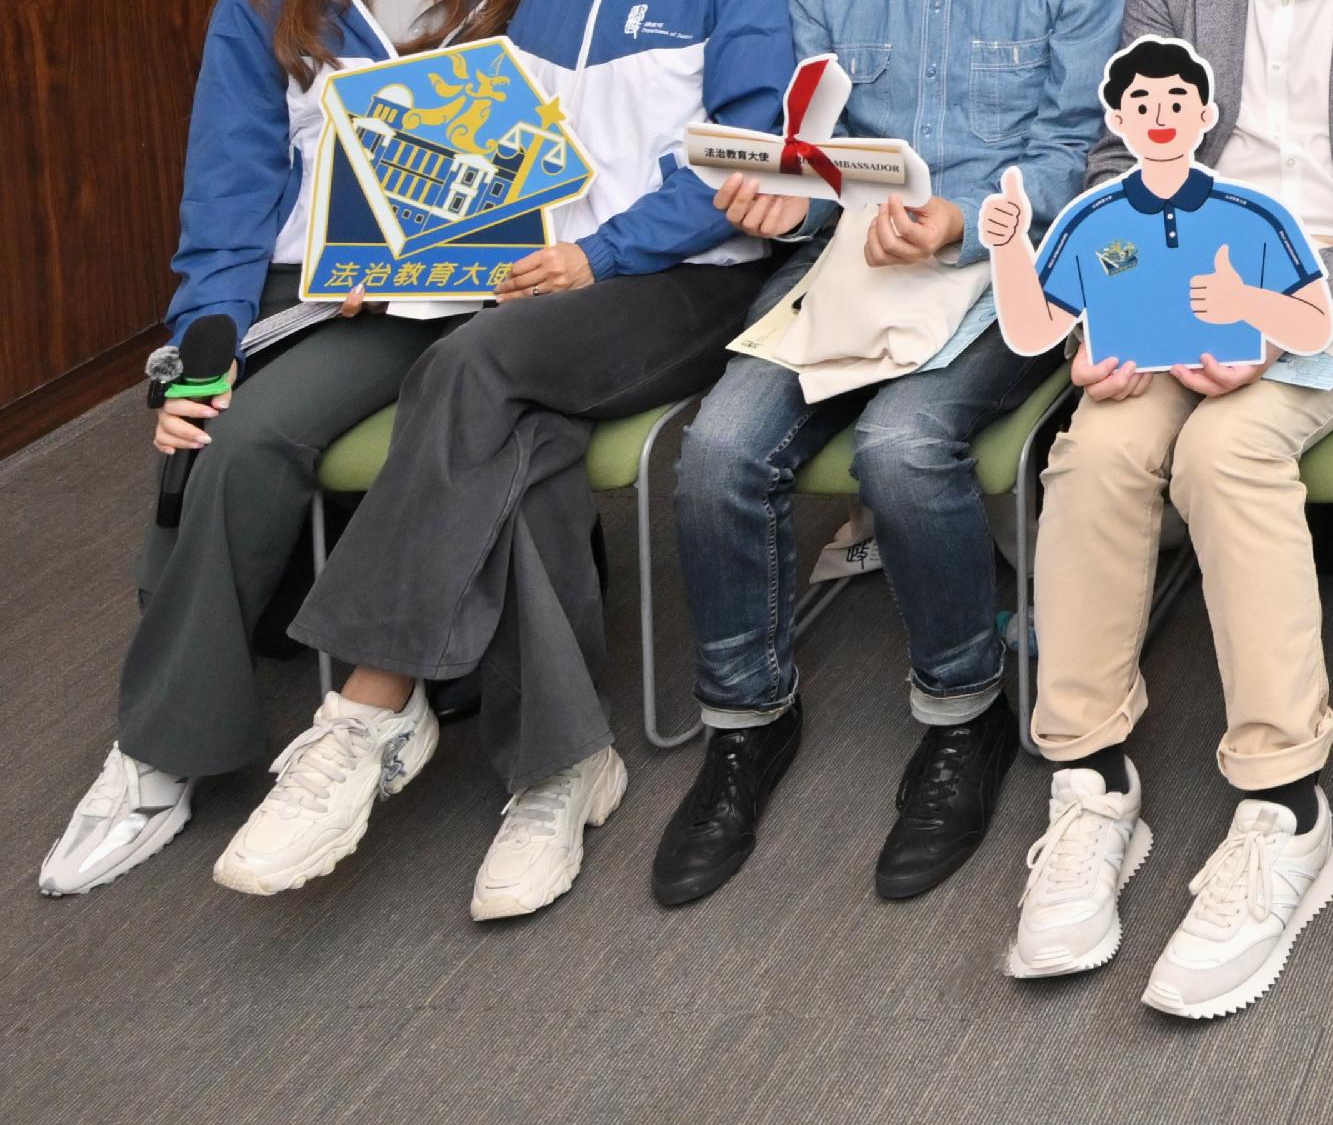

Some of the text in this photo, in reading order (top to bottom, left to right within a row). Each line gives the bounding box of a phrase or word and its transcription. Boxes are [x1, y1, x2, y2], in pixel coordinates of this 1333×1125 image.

[703, 147, 770, 163] 法治教育大使
[833, 159, 900, 173] MBASSADOR
